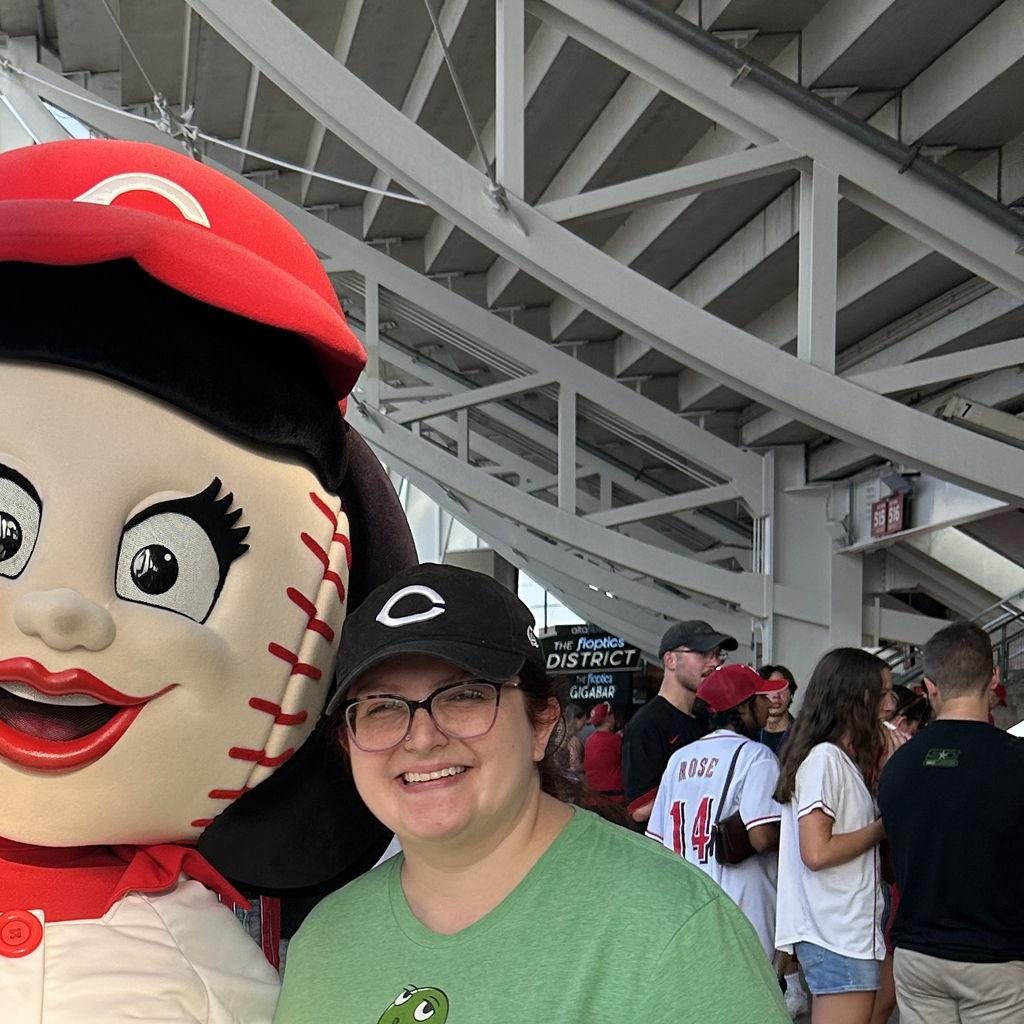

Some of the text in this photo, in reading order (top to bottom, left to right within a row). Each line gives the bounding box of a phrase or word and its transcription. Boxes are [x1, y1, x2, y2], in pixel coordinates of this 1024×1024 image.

[554, 641, 573, 651] THE
[546, 649, 636, 670] DISTRICT
[569, 685, 615, 699] GIGABAR
[678, 757, 720, 781] ROSE
[669, 797, 714, 865] 14
